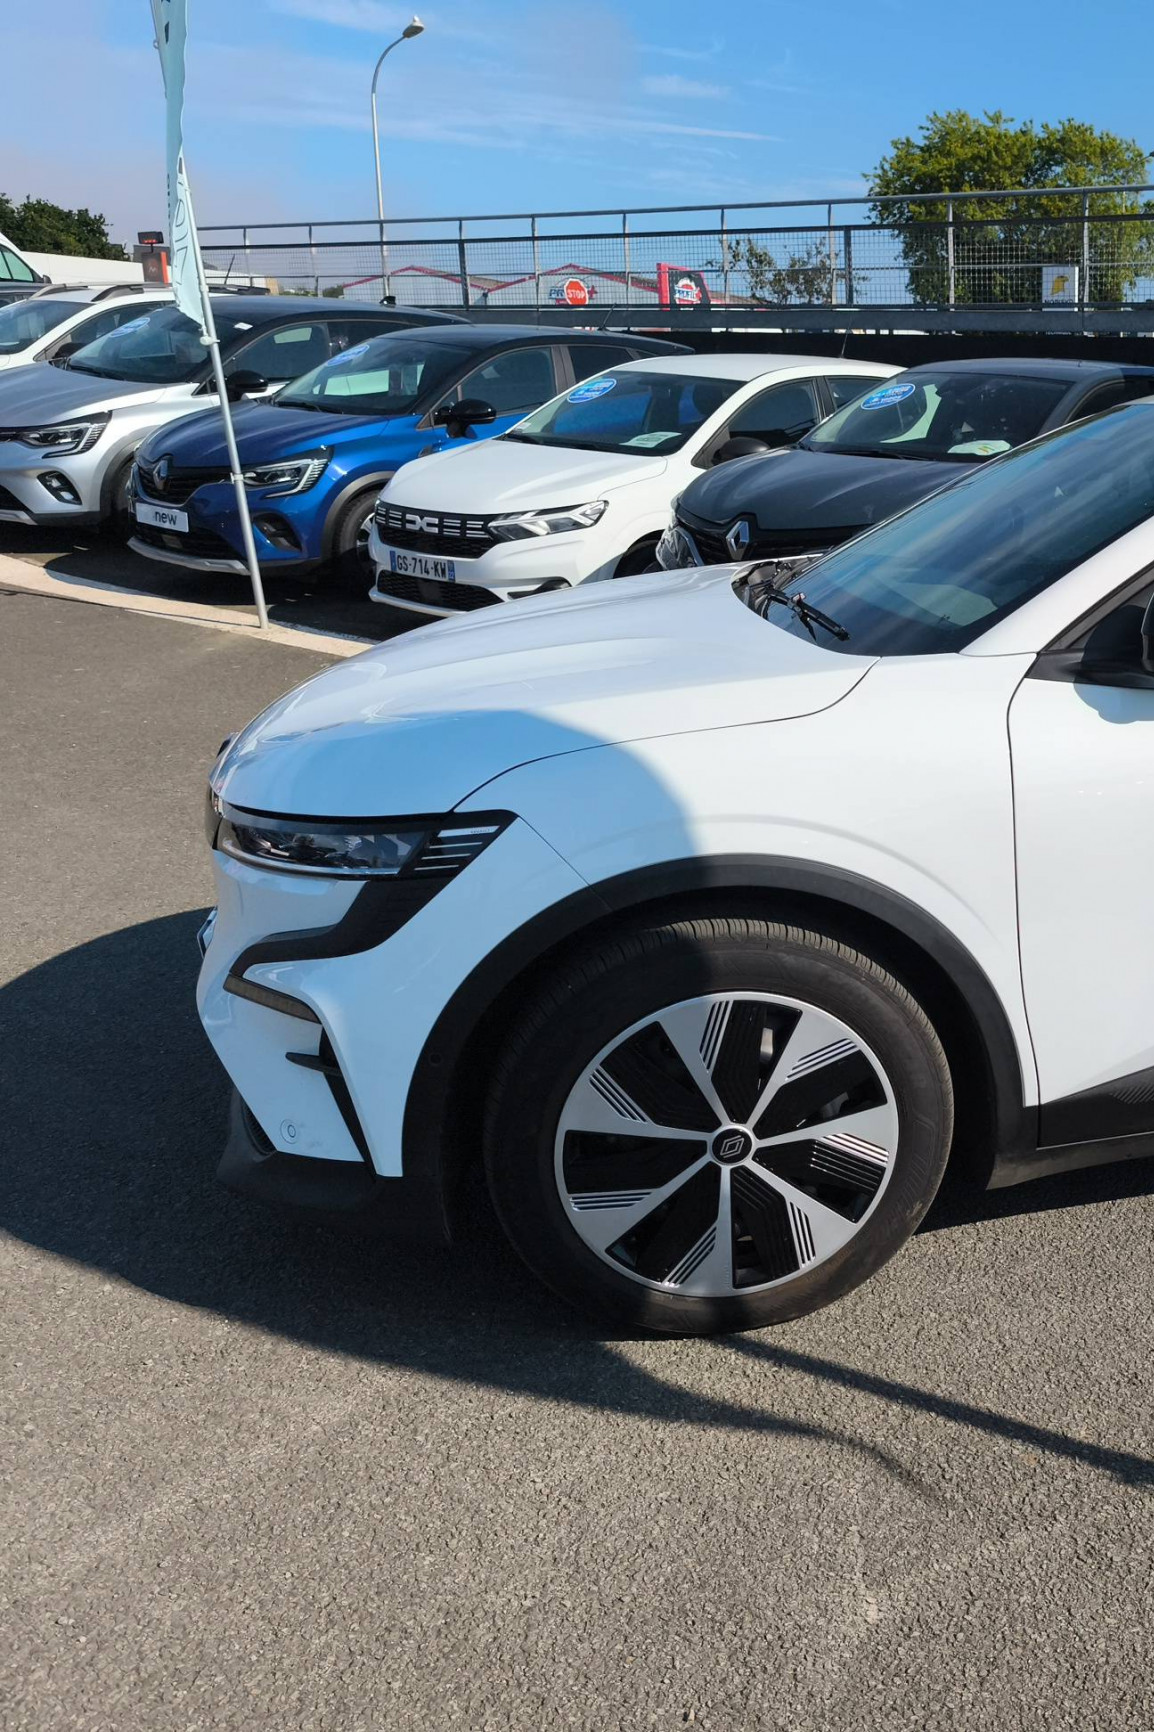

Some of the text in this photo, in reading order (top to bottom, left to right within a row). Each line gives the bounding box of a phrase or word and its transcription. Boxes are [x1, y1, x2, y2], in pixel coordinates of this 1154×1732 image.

[567, 288, 586, 300] STOP
[154, 511, 178, 526] new
[396, 554, 448, 579] GS-714-KW
